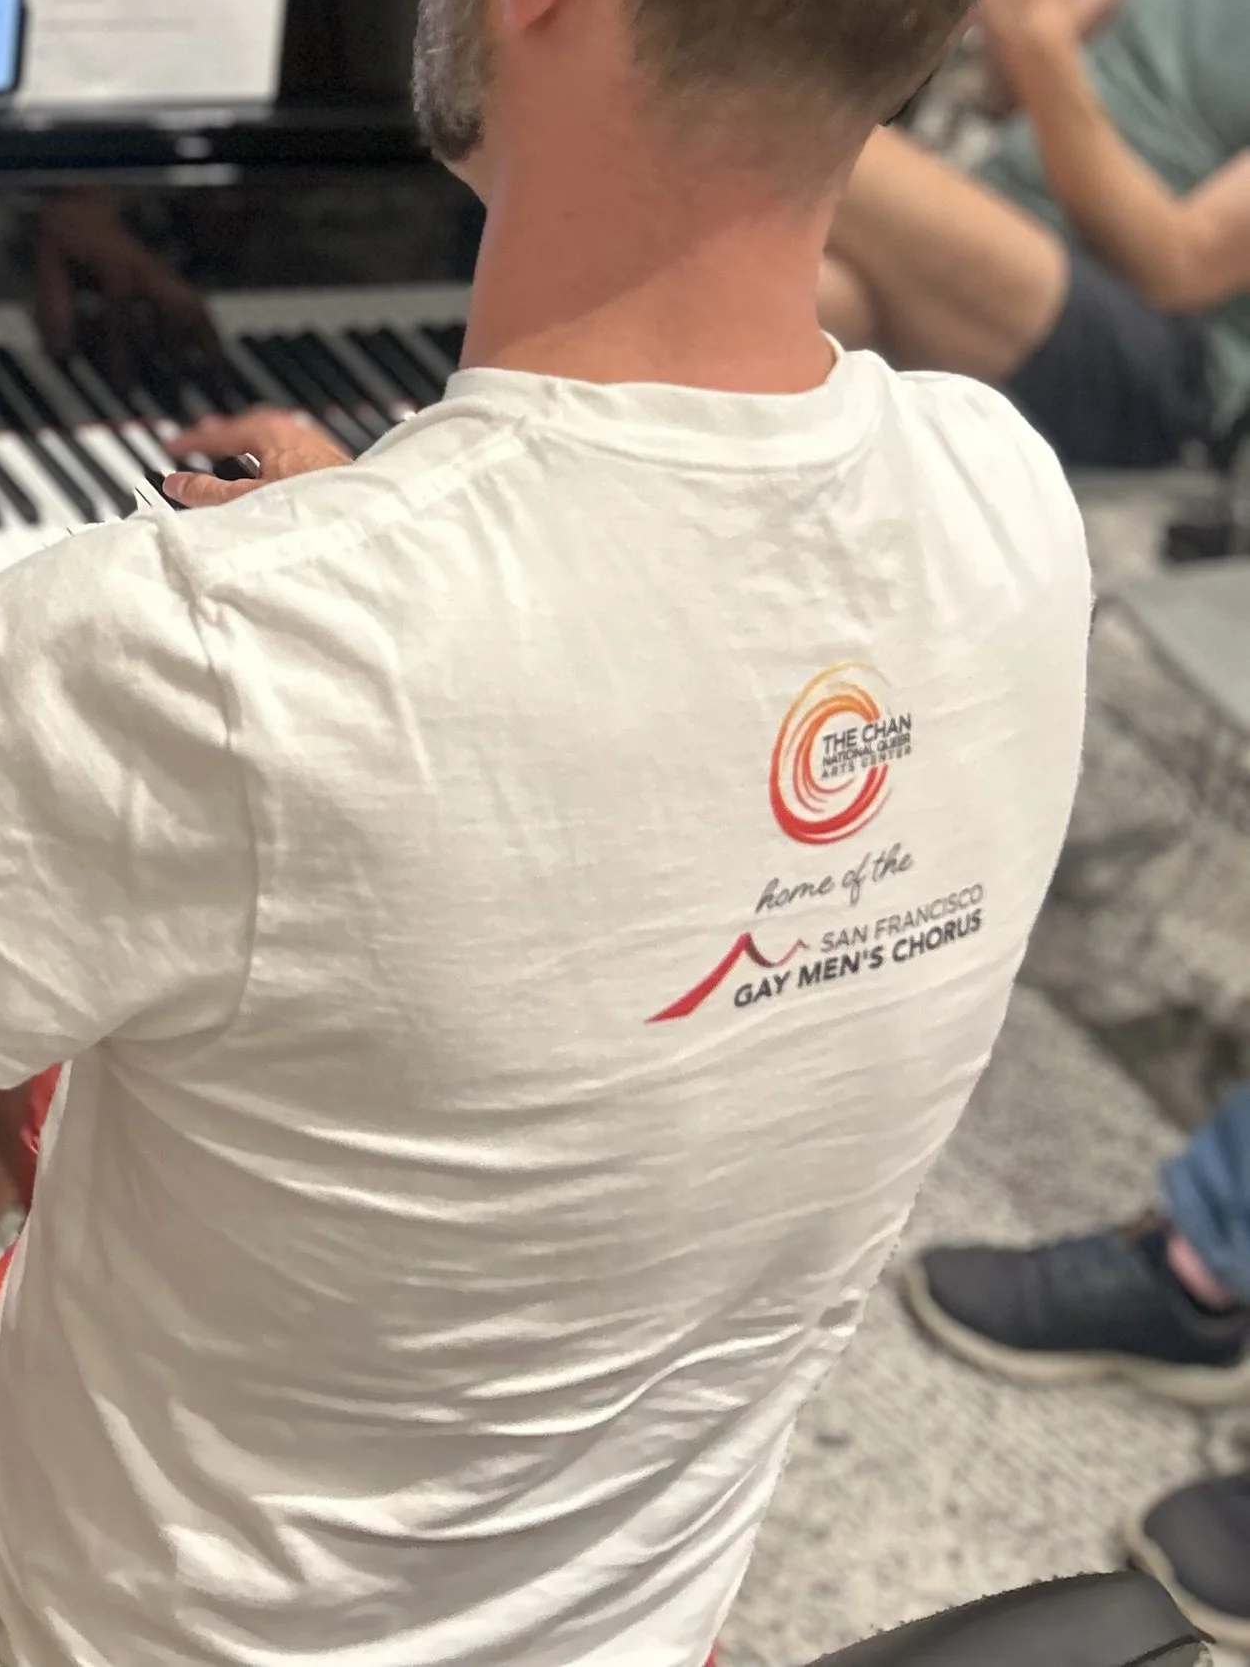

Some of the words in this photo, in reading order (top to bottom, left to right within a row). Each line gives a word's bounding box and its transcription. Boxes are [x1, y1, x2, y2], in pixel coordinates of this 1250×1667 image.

[822, 727, 857, 754] THE
[862, 713, 911, 742] CHAN
[754, 876, 835, 914] home
[841, 851, 871, 908] of
[871, 842, 914, 882] the
[820, 924, 868, 953] SAN
[874, 883, 984, 940] FRANCISCO
[733, 970, 791, 1008] GAY
[797, 945, 884, 989] MEN'S
[892, 907, 983, 964] CHORUS
